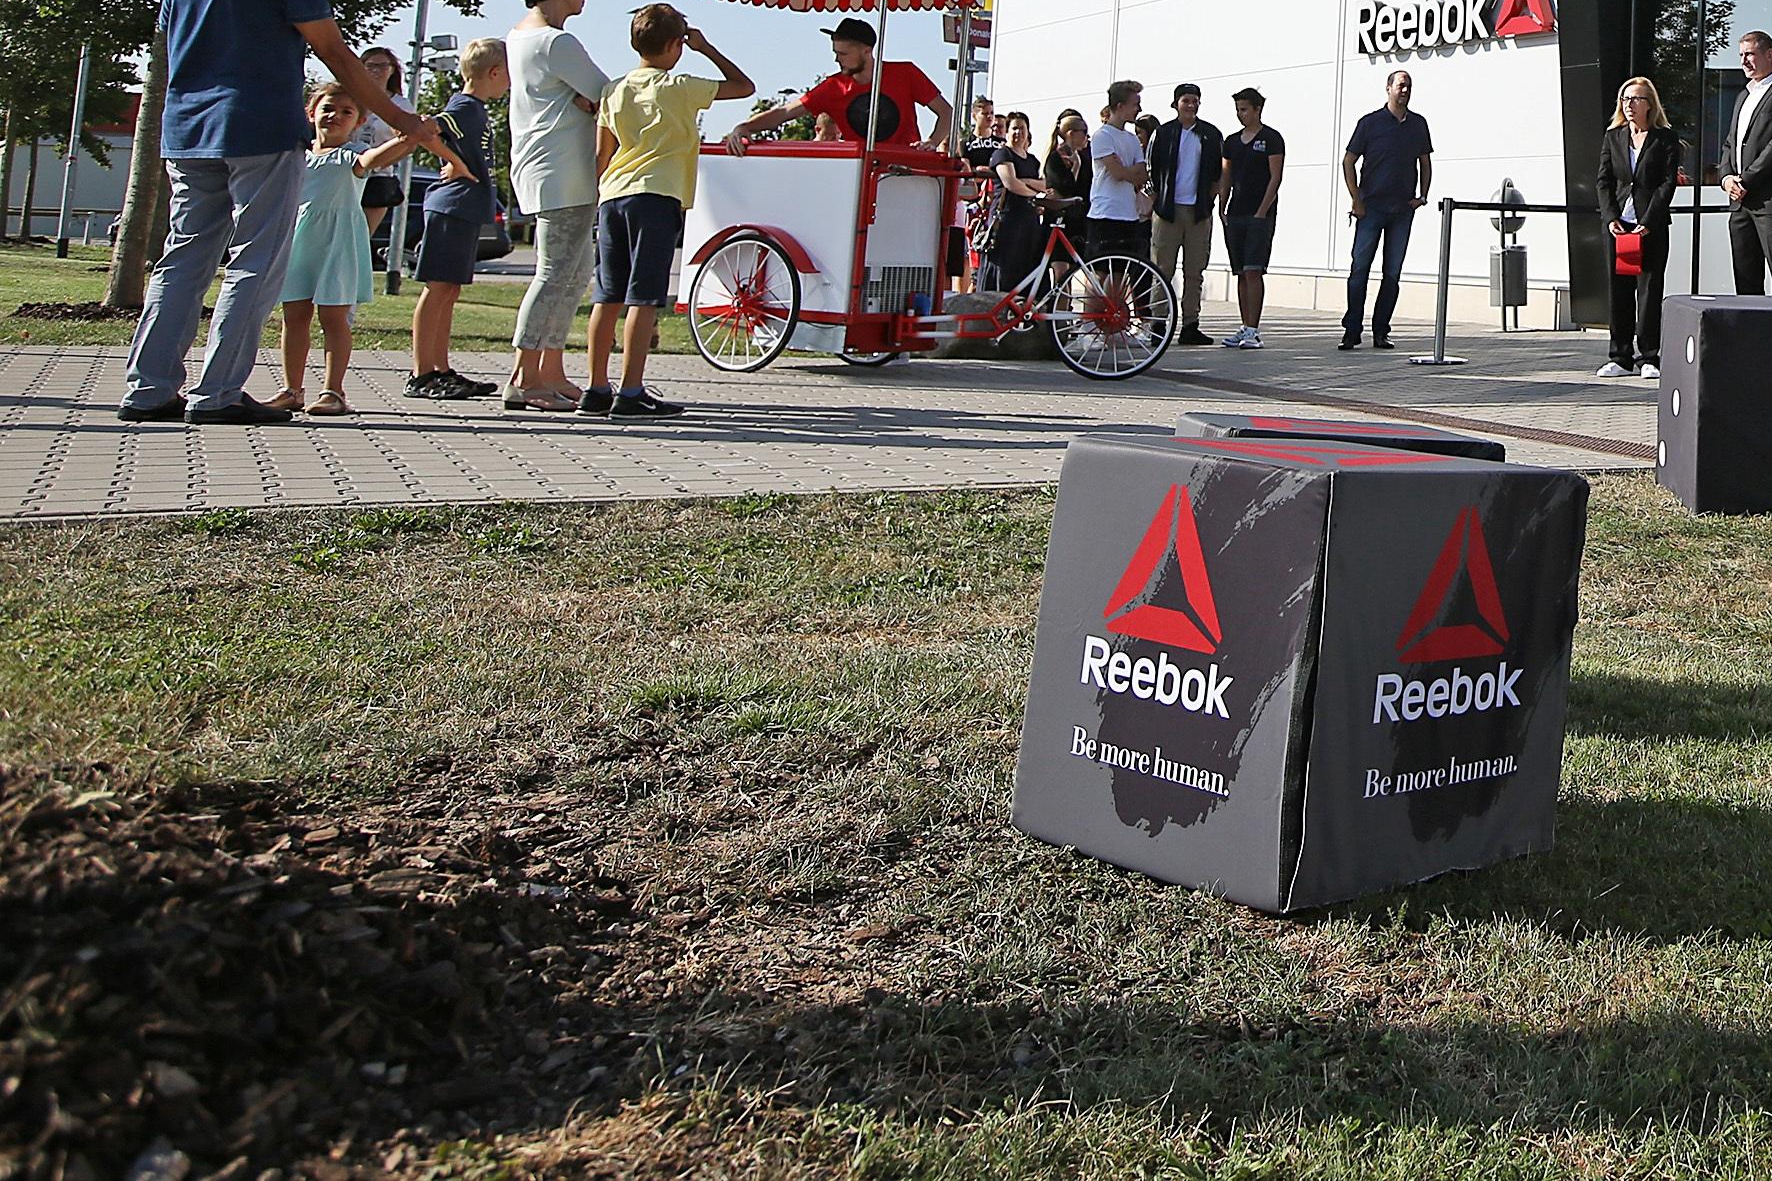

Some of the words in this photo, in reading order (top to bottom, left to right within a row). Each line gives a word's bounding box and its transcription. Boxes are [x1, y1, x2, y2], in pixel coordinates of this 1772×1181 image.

[1081, 635, 1234, 719] Reebok
[1373, 661, 1524, 724] Reebok
[1070, 725, 1097, 760] Be
[1100, 742, 1150, 774] more
[1152, 747, 1230, 797] human.
[1363, 769, 1391, 799] Be
[1395, 767, 1446, 794] more
[1449, 754, 1518, 785] human.
